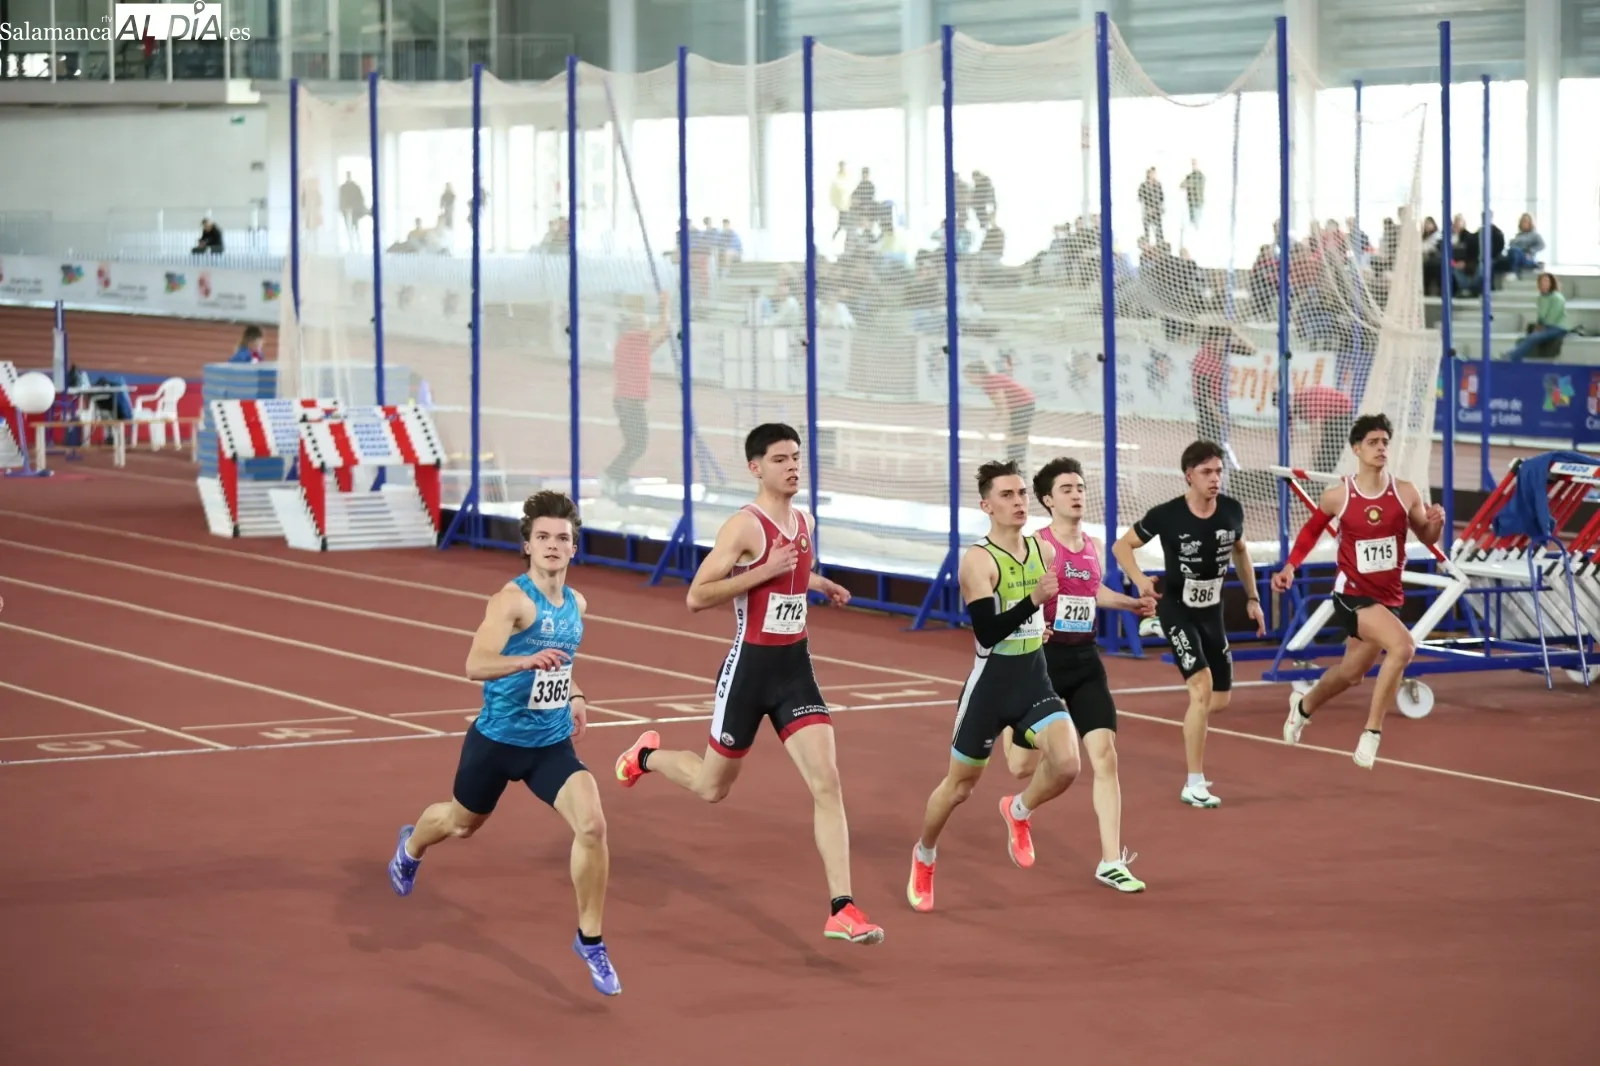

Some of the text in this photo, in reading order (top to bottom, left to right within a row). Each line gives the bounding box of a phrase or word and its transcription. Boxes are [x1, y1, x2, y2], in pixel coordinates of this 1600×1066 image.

[1364, 544, 1392, 561] 1715
[1190, 587, 1214, 603] 386
[776, 603, 803, 620] 1712
[1064, 605, 1090, 621] 2120
[718, 608, 744, 698] C.A. VALLADOLID
[534, 678, 569, 703] 3365
[258, 727, 354, 739] 4
